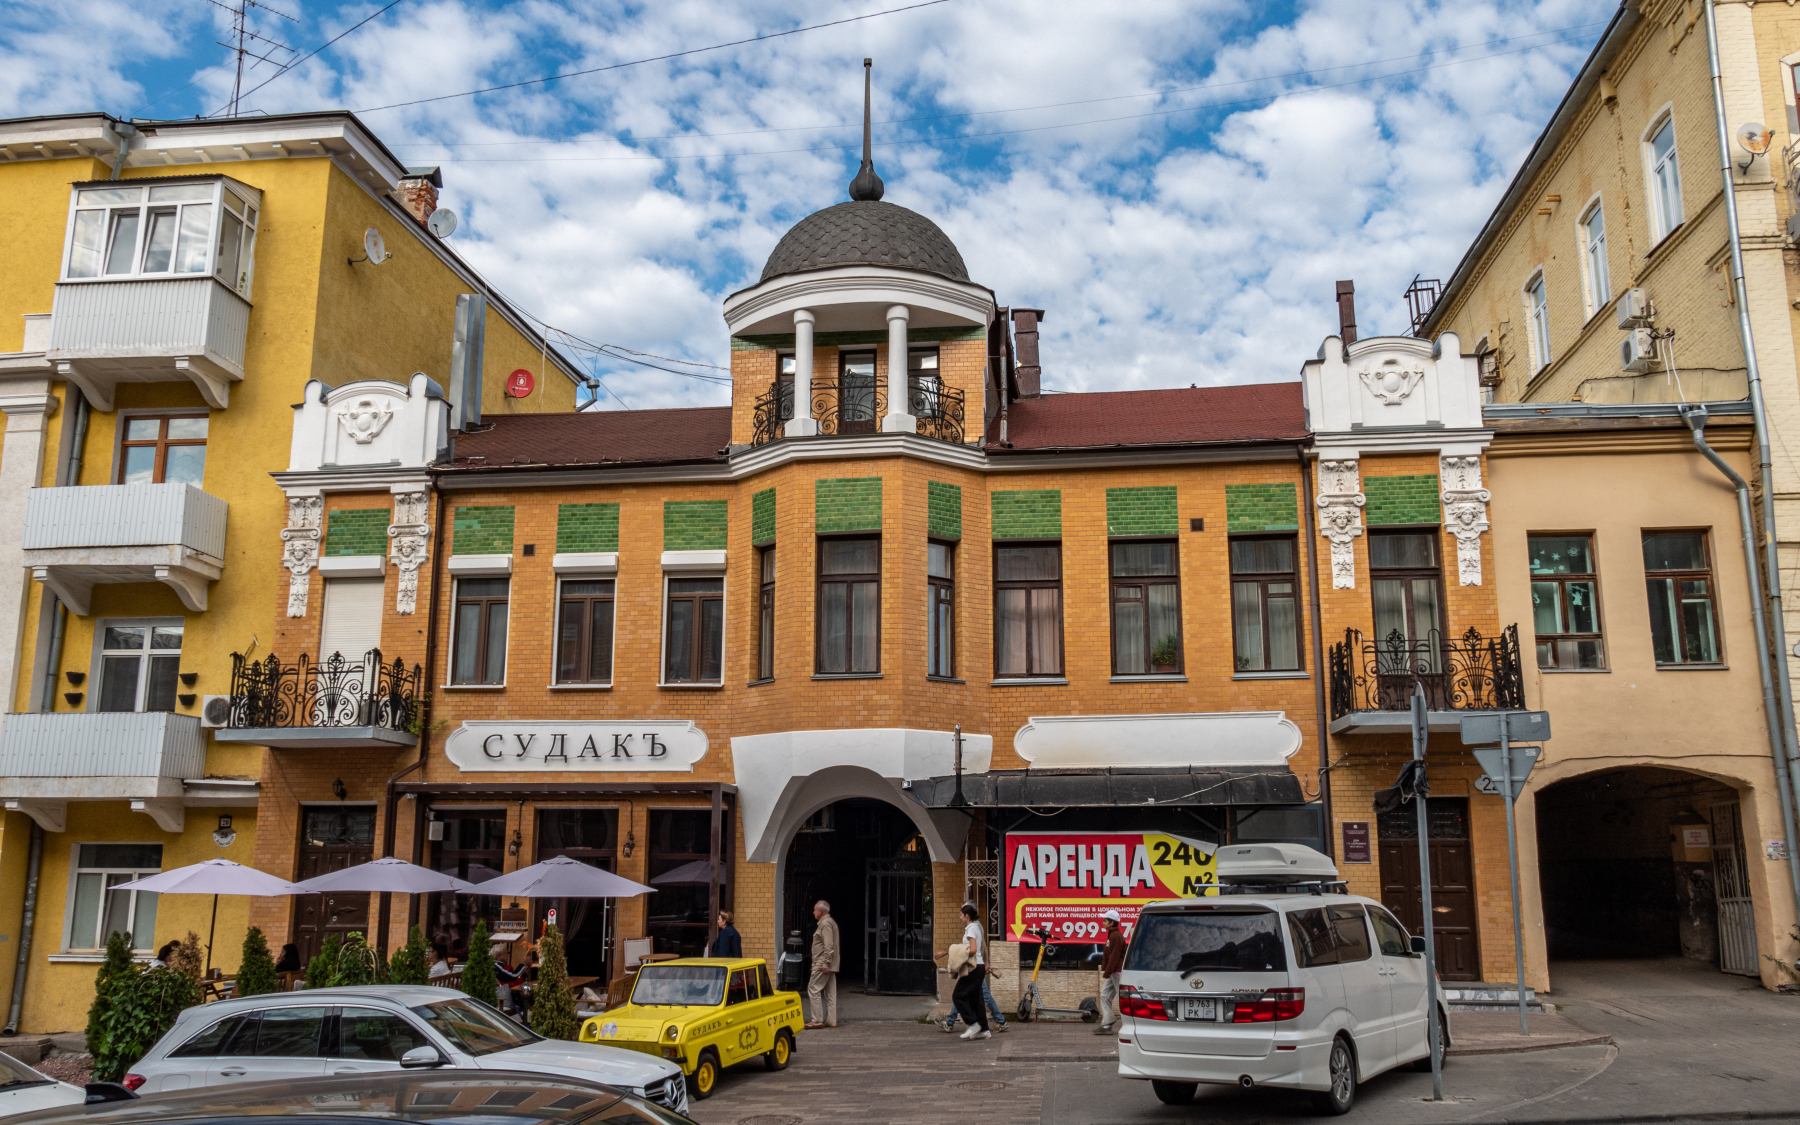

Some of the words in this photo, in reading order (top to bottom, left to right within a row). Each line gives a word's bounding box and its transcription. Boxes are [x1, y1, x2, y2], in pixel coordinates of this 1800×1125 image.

[482, 733, 667, 763] СУДАКЪ
[1482, 777, 1498, 791] 2
[1009, 843, 1156, 896] АРЕНДА
[1196, 999, 1210, 1008] 763
[768, 1009, 801, 1026] СУДАКЪ
[693, 1021, 721, 1036] СУДАКЪ
